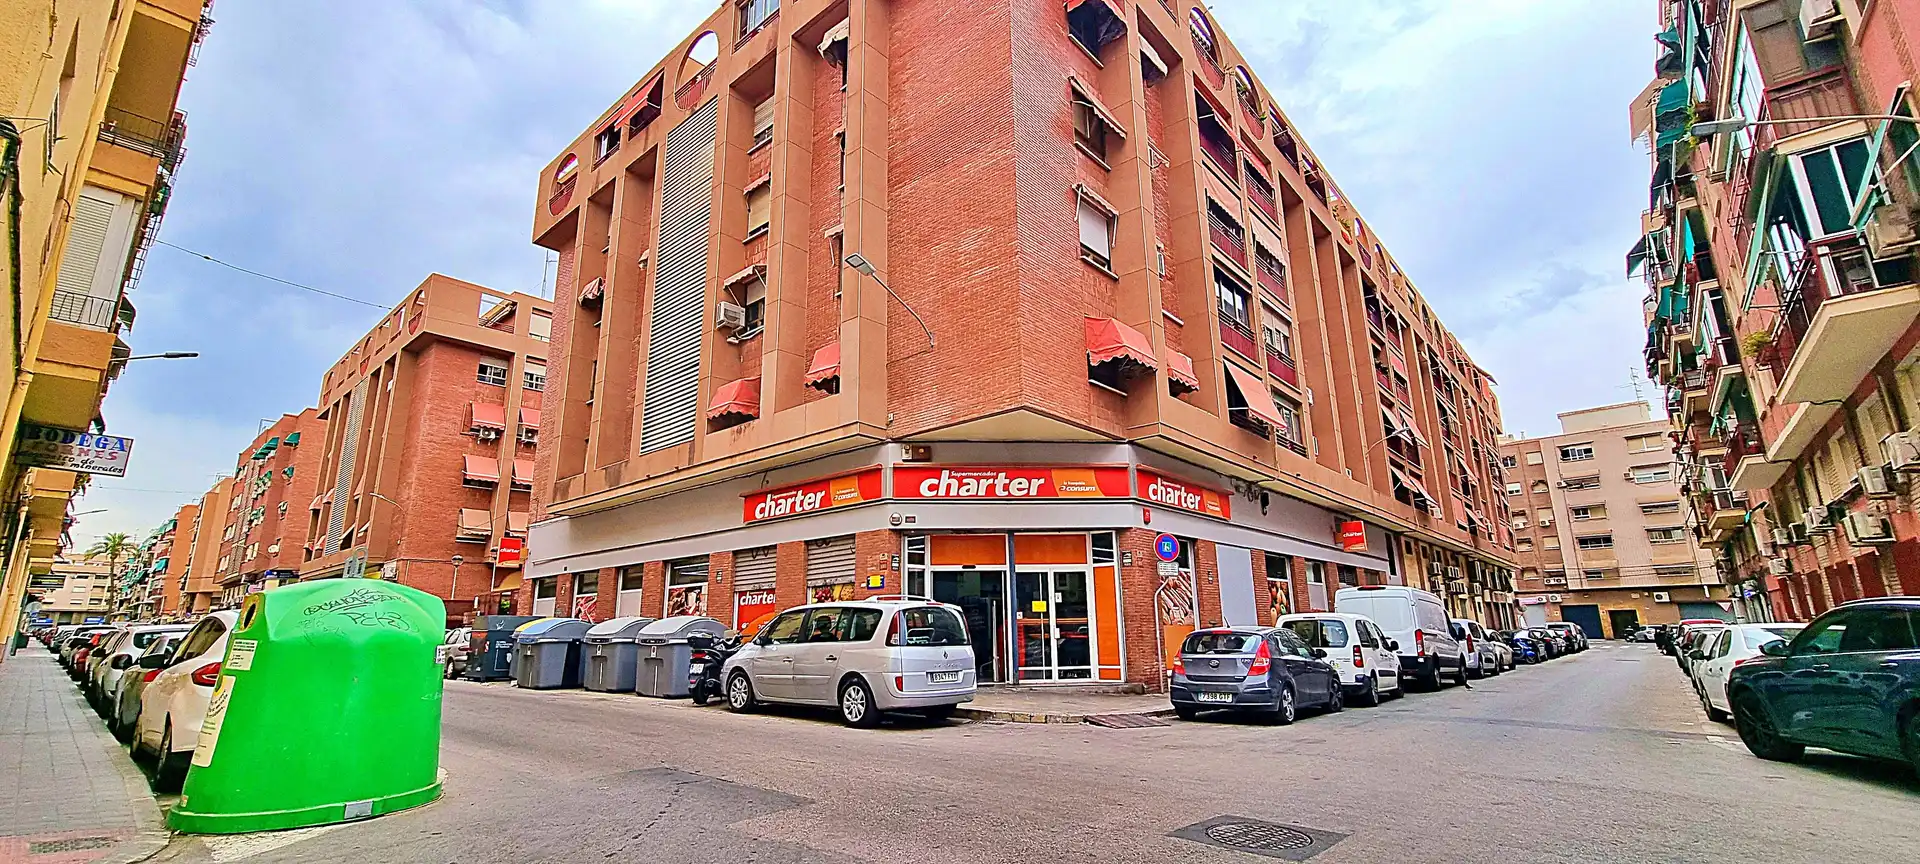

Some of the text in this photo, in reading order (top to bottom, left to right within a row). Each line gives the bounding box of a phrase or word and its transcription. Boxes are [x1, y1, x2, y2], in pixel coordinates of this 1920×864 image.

[27, 426, 127, 452] BODEGA
[70, 461, 124, 474] minerales
[919, 469, 1044, 497] charter
[1148, 477, 1201, 510] charter
[755, 489, 825, 519] charter
